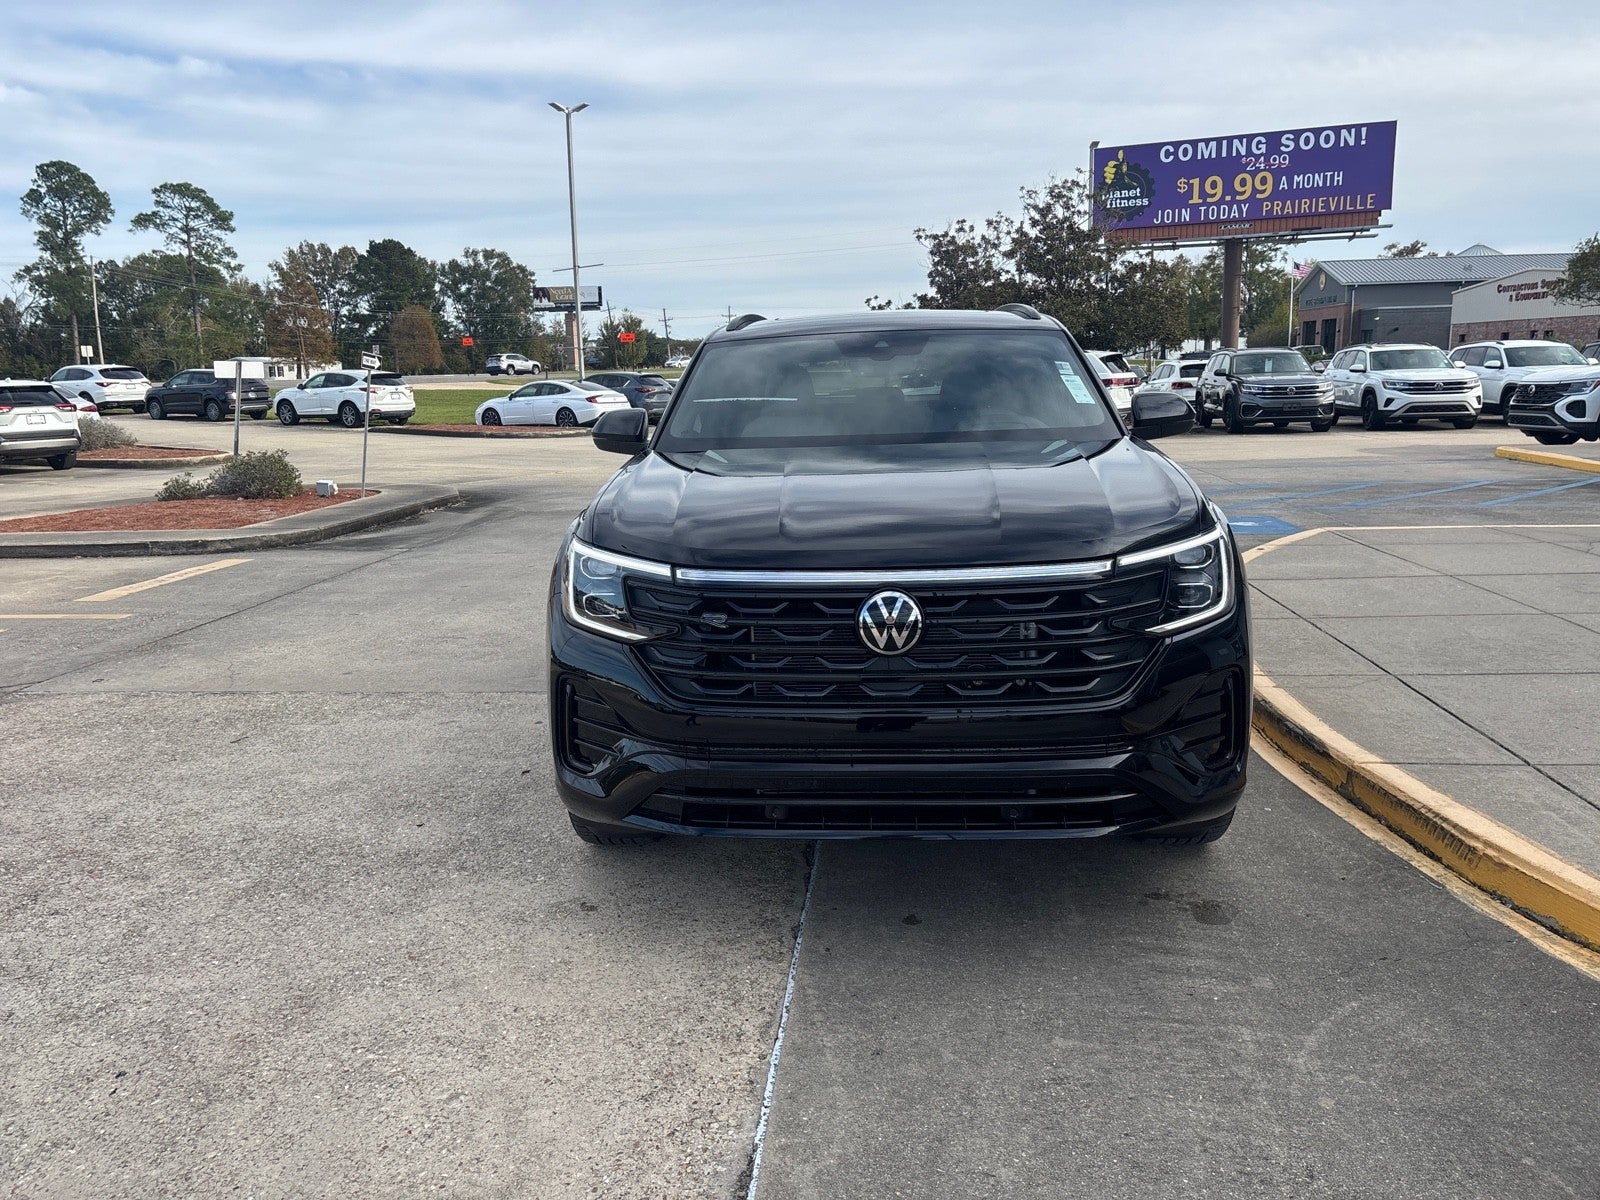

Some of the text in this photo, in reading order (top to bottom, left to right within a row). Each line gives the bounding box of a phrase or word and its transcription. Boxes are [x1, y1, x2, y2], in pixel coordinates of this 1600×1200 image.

[1160, 127, 1367, 163] COMING SOON!
[1242, 154, 1290, 171] $24.99
[1106, 197, 1149, 209] fitness
[1177, 171, 1343, 204] $19.99 A MONTH
[1154, 193, 1376, 224] JOIN TODAY PRAIRIEVILLE
